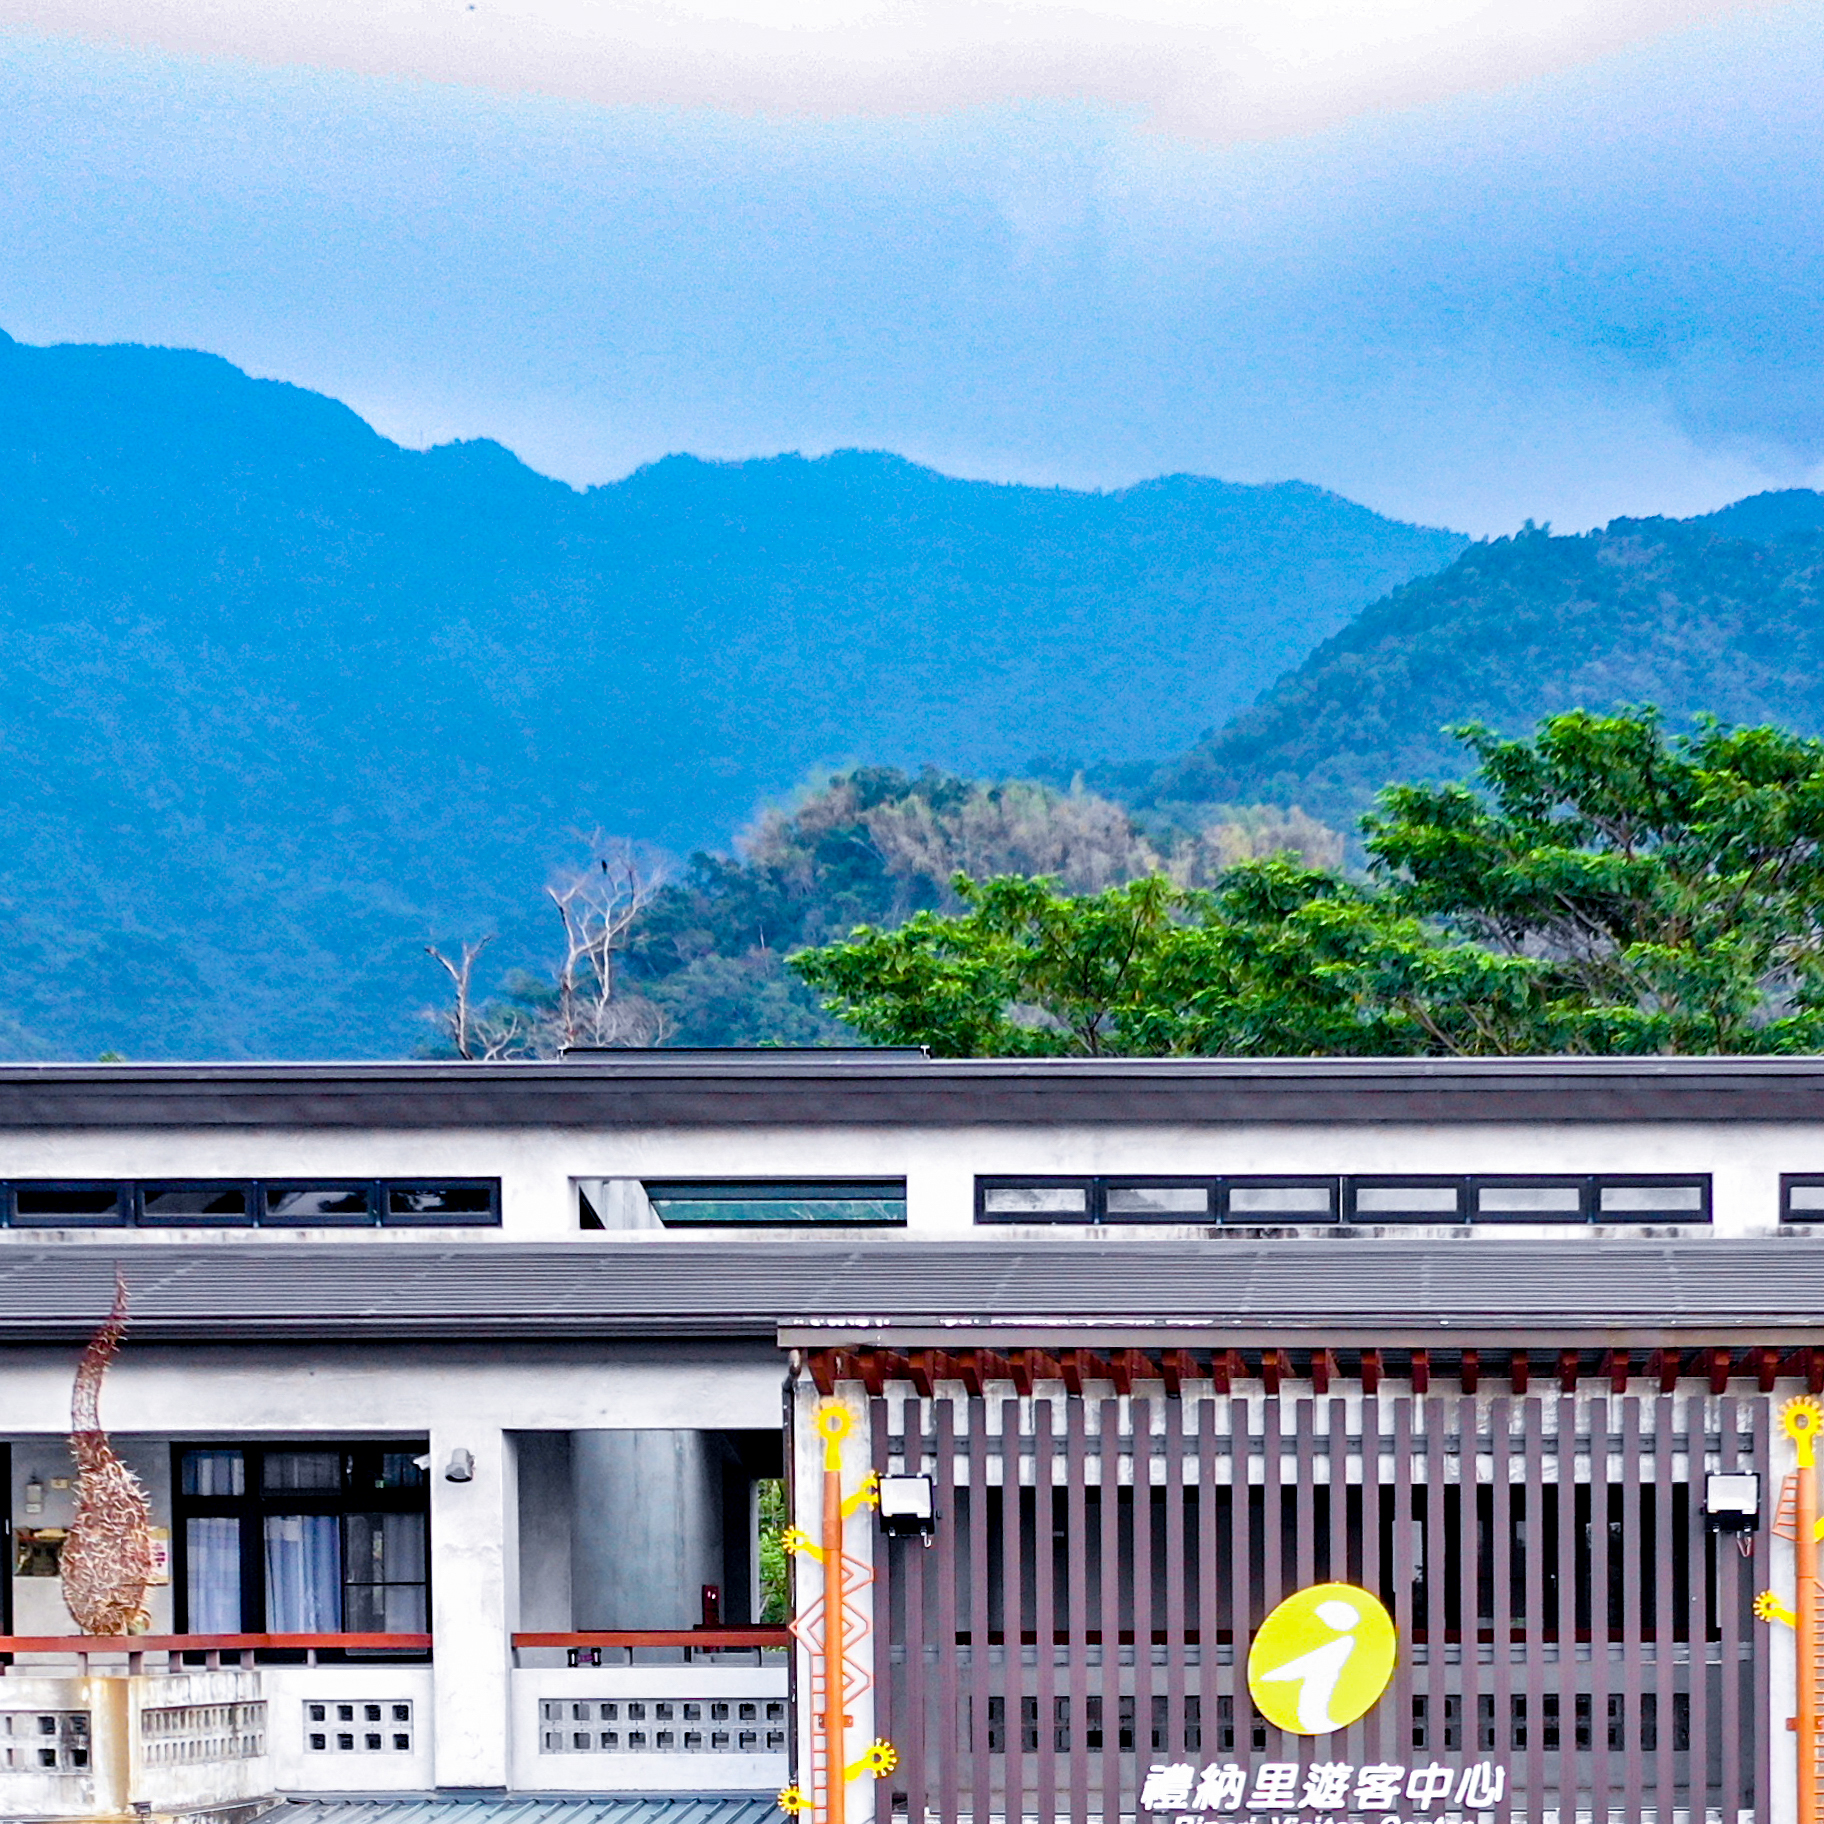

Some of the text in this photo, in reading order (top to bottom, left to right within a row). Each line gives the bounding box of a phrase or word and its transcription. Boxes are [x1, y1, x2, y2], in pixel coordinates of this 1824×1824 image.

[1140, 1761, 1506, 1811] 禮納里遊客中心
